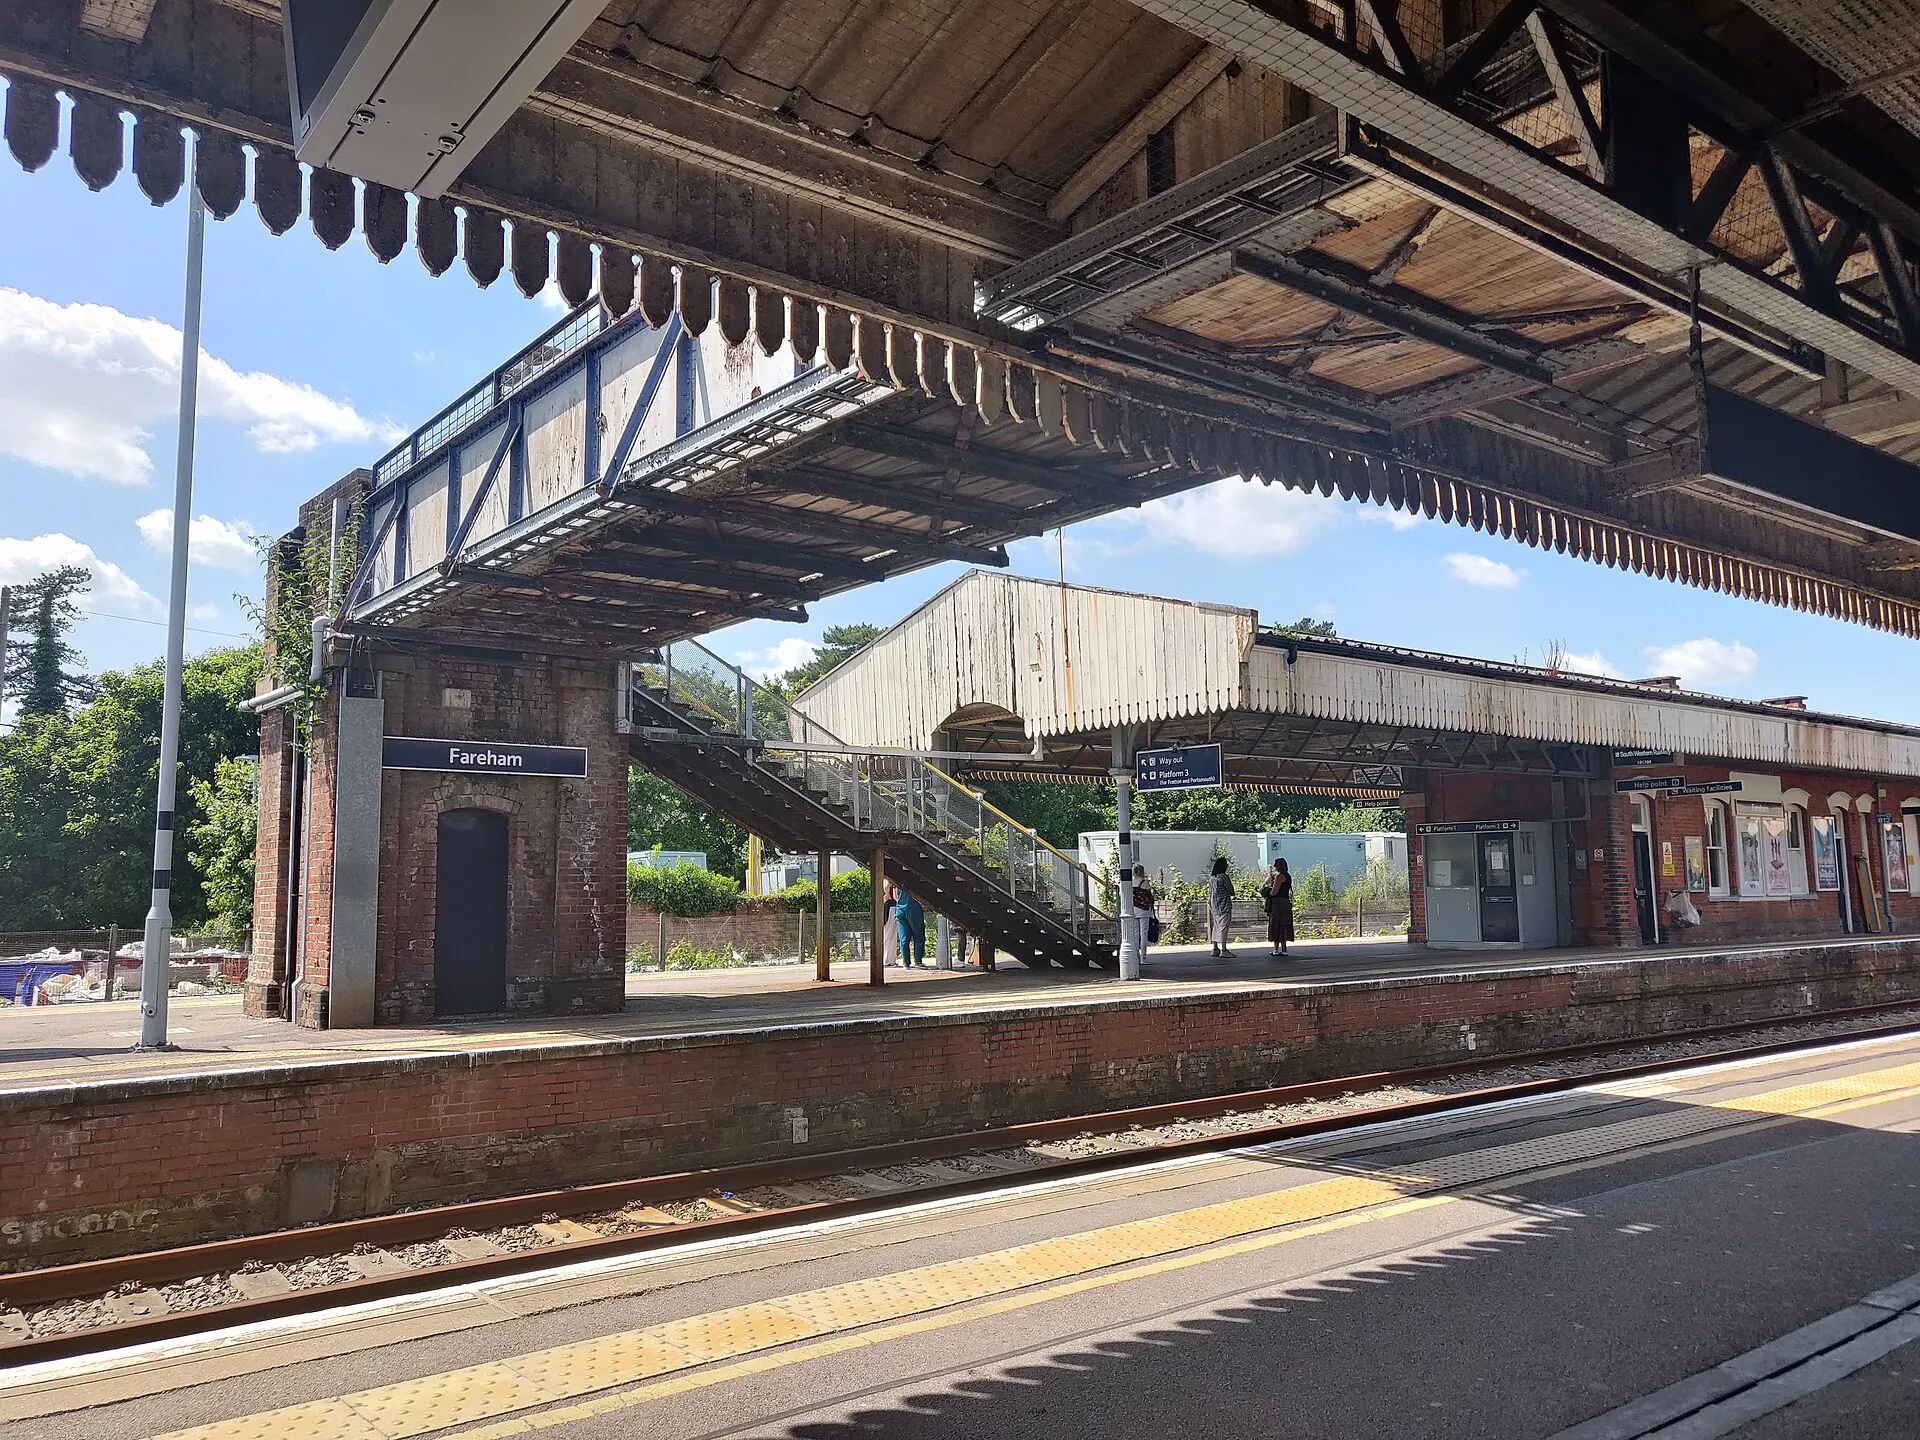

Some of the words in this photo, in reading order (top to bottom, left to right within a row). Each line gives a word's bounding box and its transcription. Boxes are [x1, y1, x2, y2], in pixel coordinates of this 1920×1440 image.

[449, 748, 523, 767] Fareham
[1159, 757, 1171, 766] Way
[1159, 770, 1184, 779] Platform
[1184, 768, 1189, 777] 3
[1682, 786, 1705, 794] Waiting
[1706, 783, 1733, 792] facilities
[1433, 825, 1453, 833] Platform
